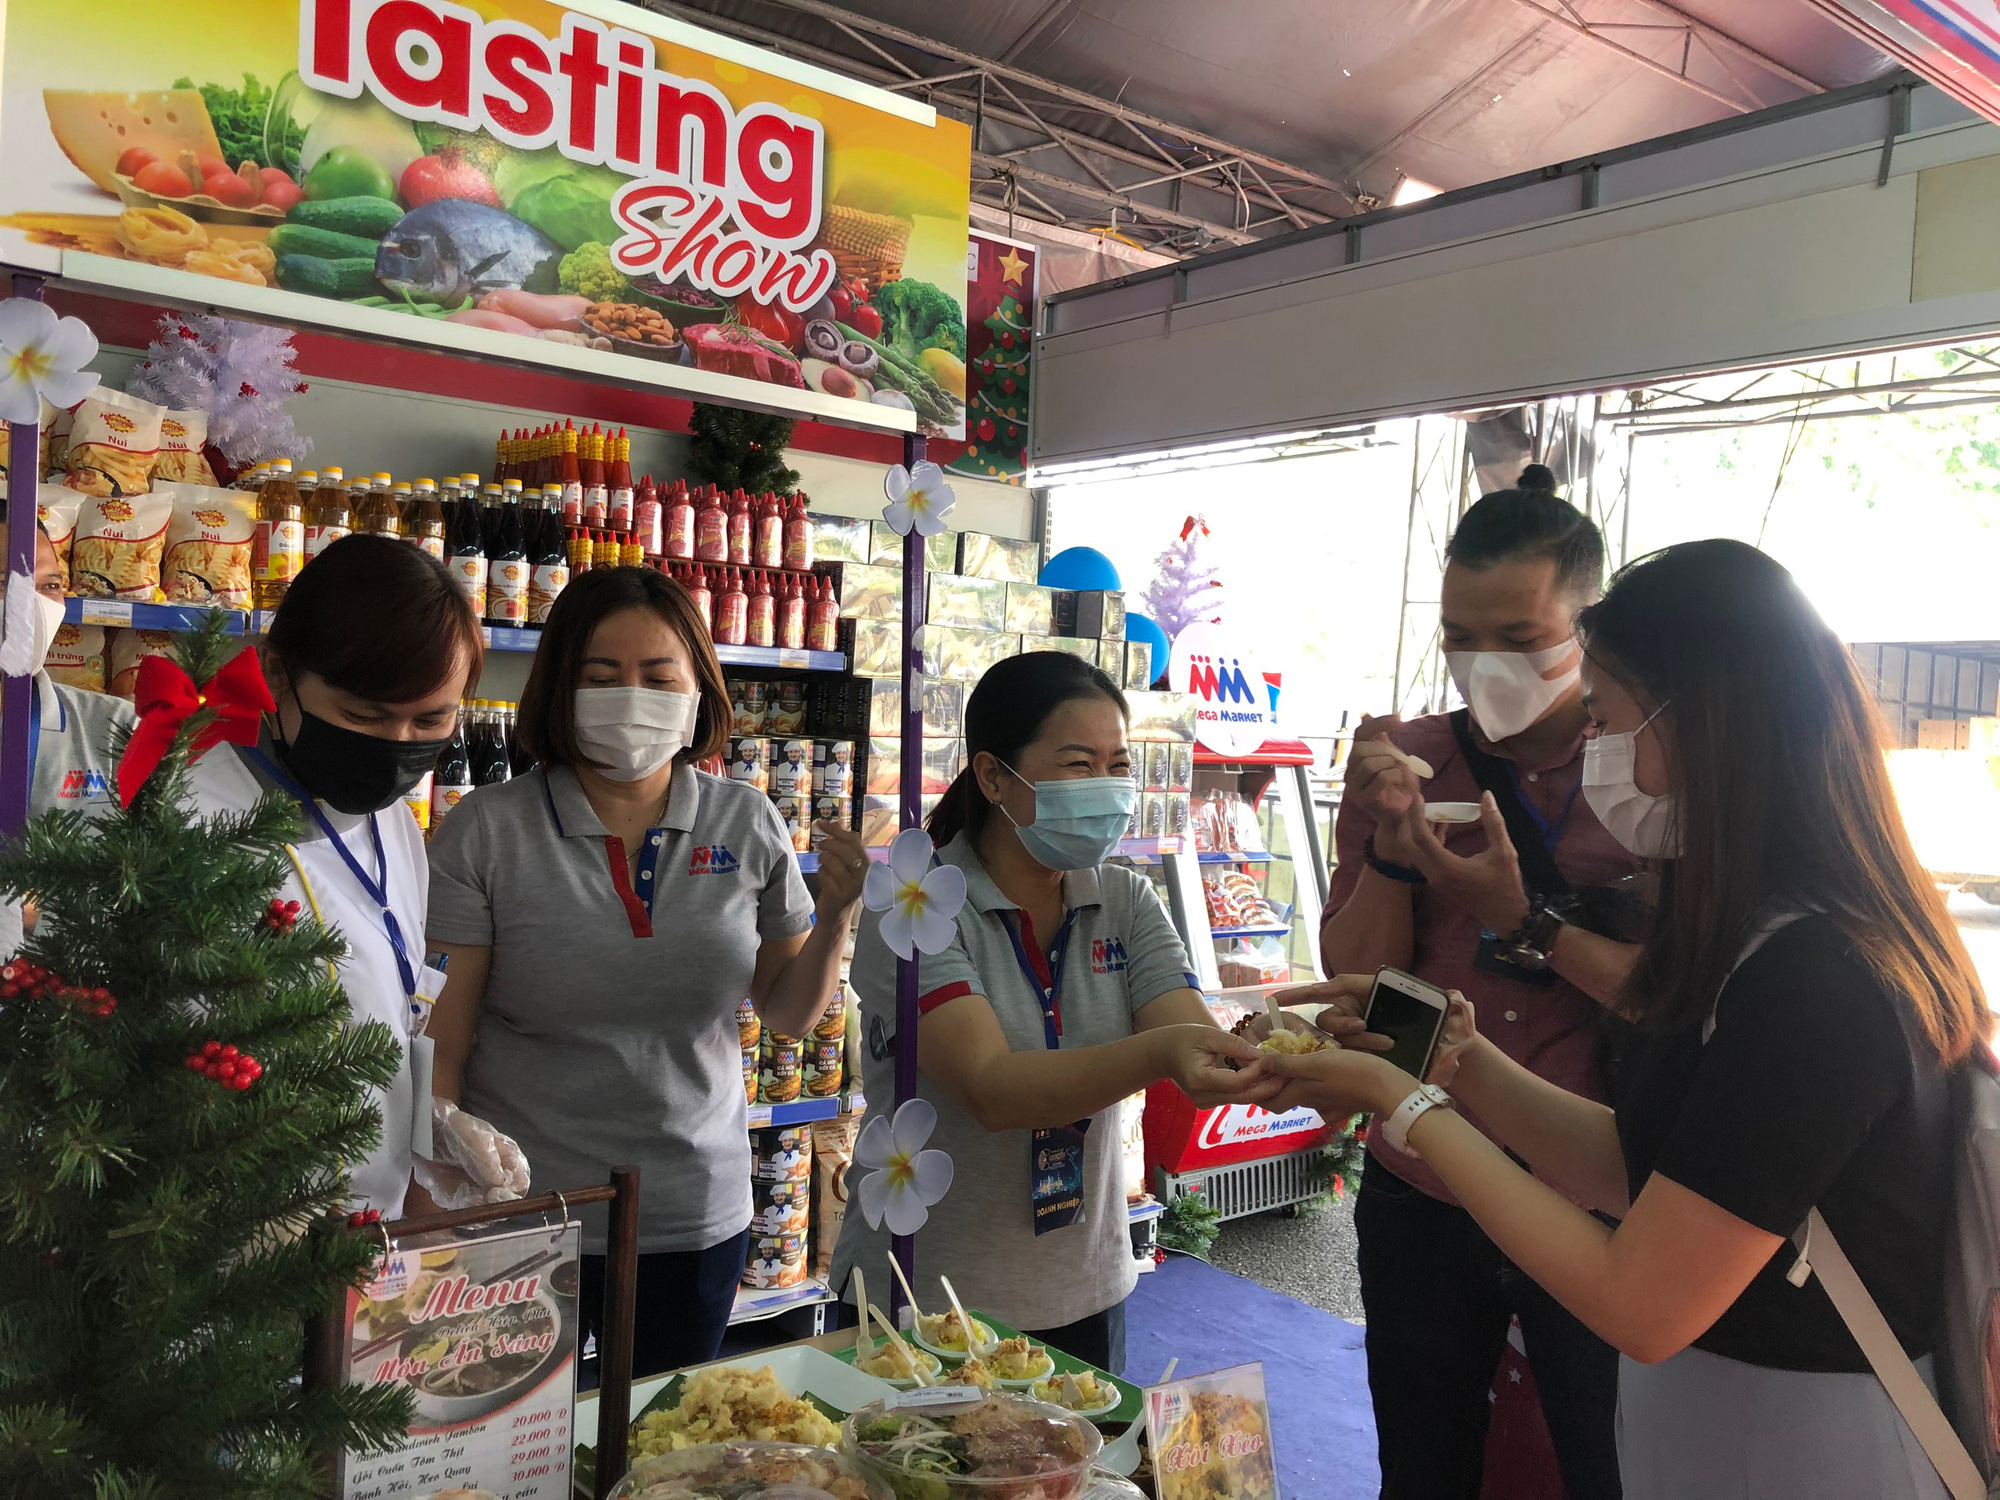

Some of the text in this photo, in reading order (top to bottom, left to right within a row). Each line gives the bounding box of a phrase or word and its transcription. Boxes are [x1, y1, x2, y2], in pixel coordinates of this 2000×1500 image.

[618, 185, 829, 304] Show
[108, 435, 128, 448] Nui
[168, 441, 187, 450] Nui
[103, 528, 124, 539] Nui
[201, 530, 220, 541] Nui
[56, 651, 84, 663] trứng
[1197, 710, 1218, 721] ega
[1037, 1197, 1080, 1217] DOANH NGHIỆP
[410, 1275, 541, 1323] Menu
[368, 1331, 554, 1384] Món Ăn Sáng
[512, 1410, 552, 1429] 20.000
[445, 1425, 487, 1442] Jambon
[511, 1428, 551, 1447] 22.000
[410, 1456, 435, 1469] Tôm
[441, 1446, 465, 1459] Thịt
[511, 1446, 550, 1465] 29.000
[1166, 1431, 1263, 1472] Xôi Xéo
[444, 1465, 472, 1480] Quay
